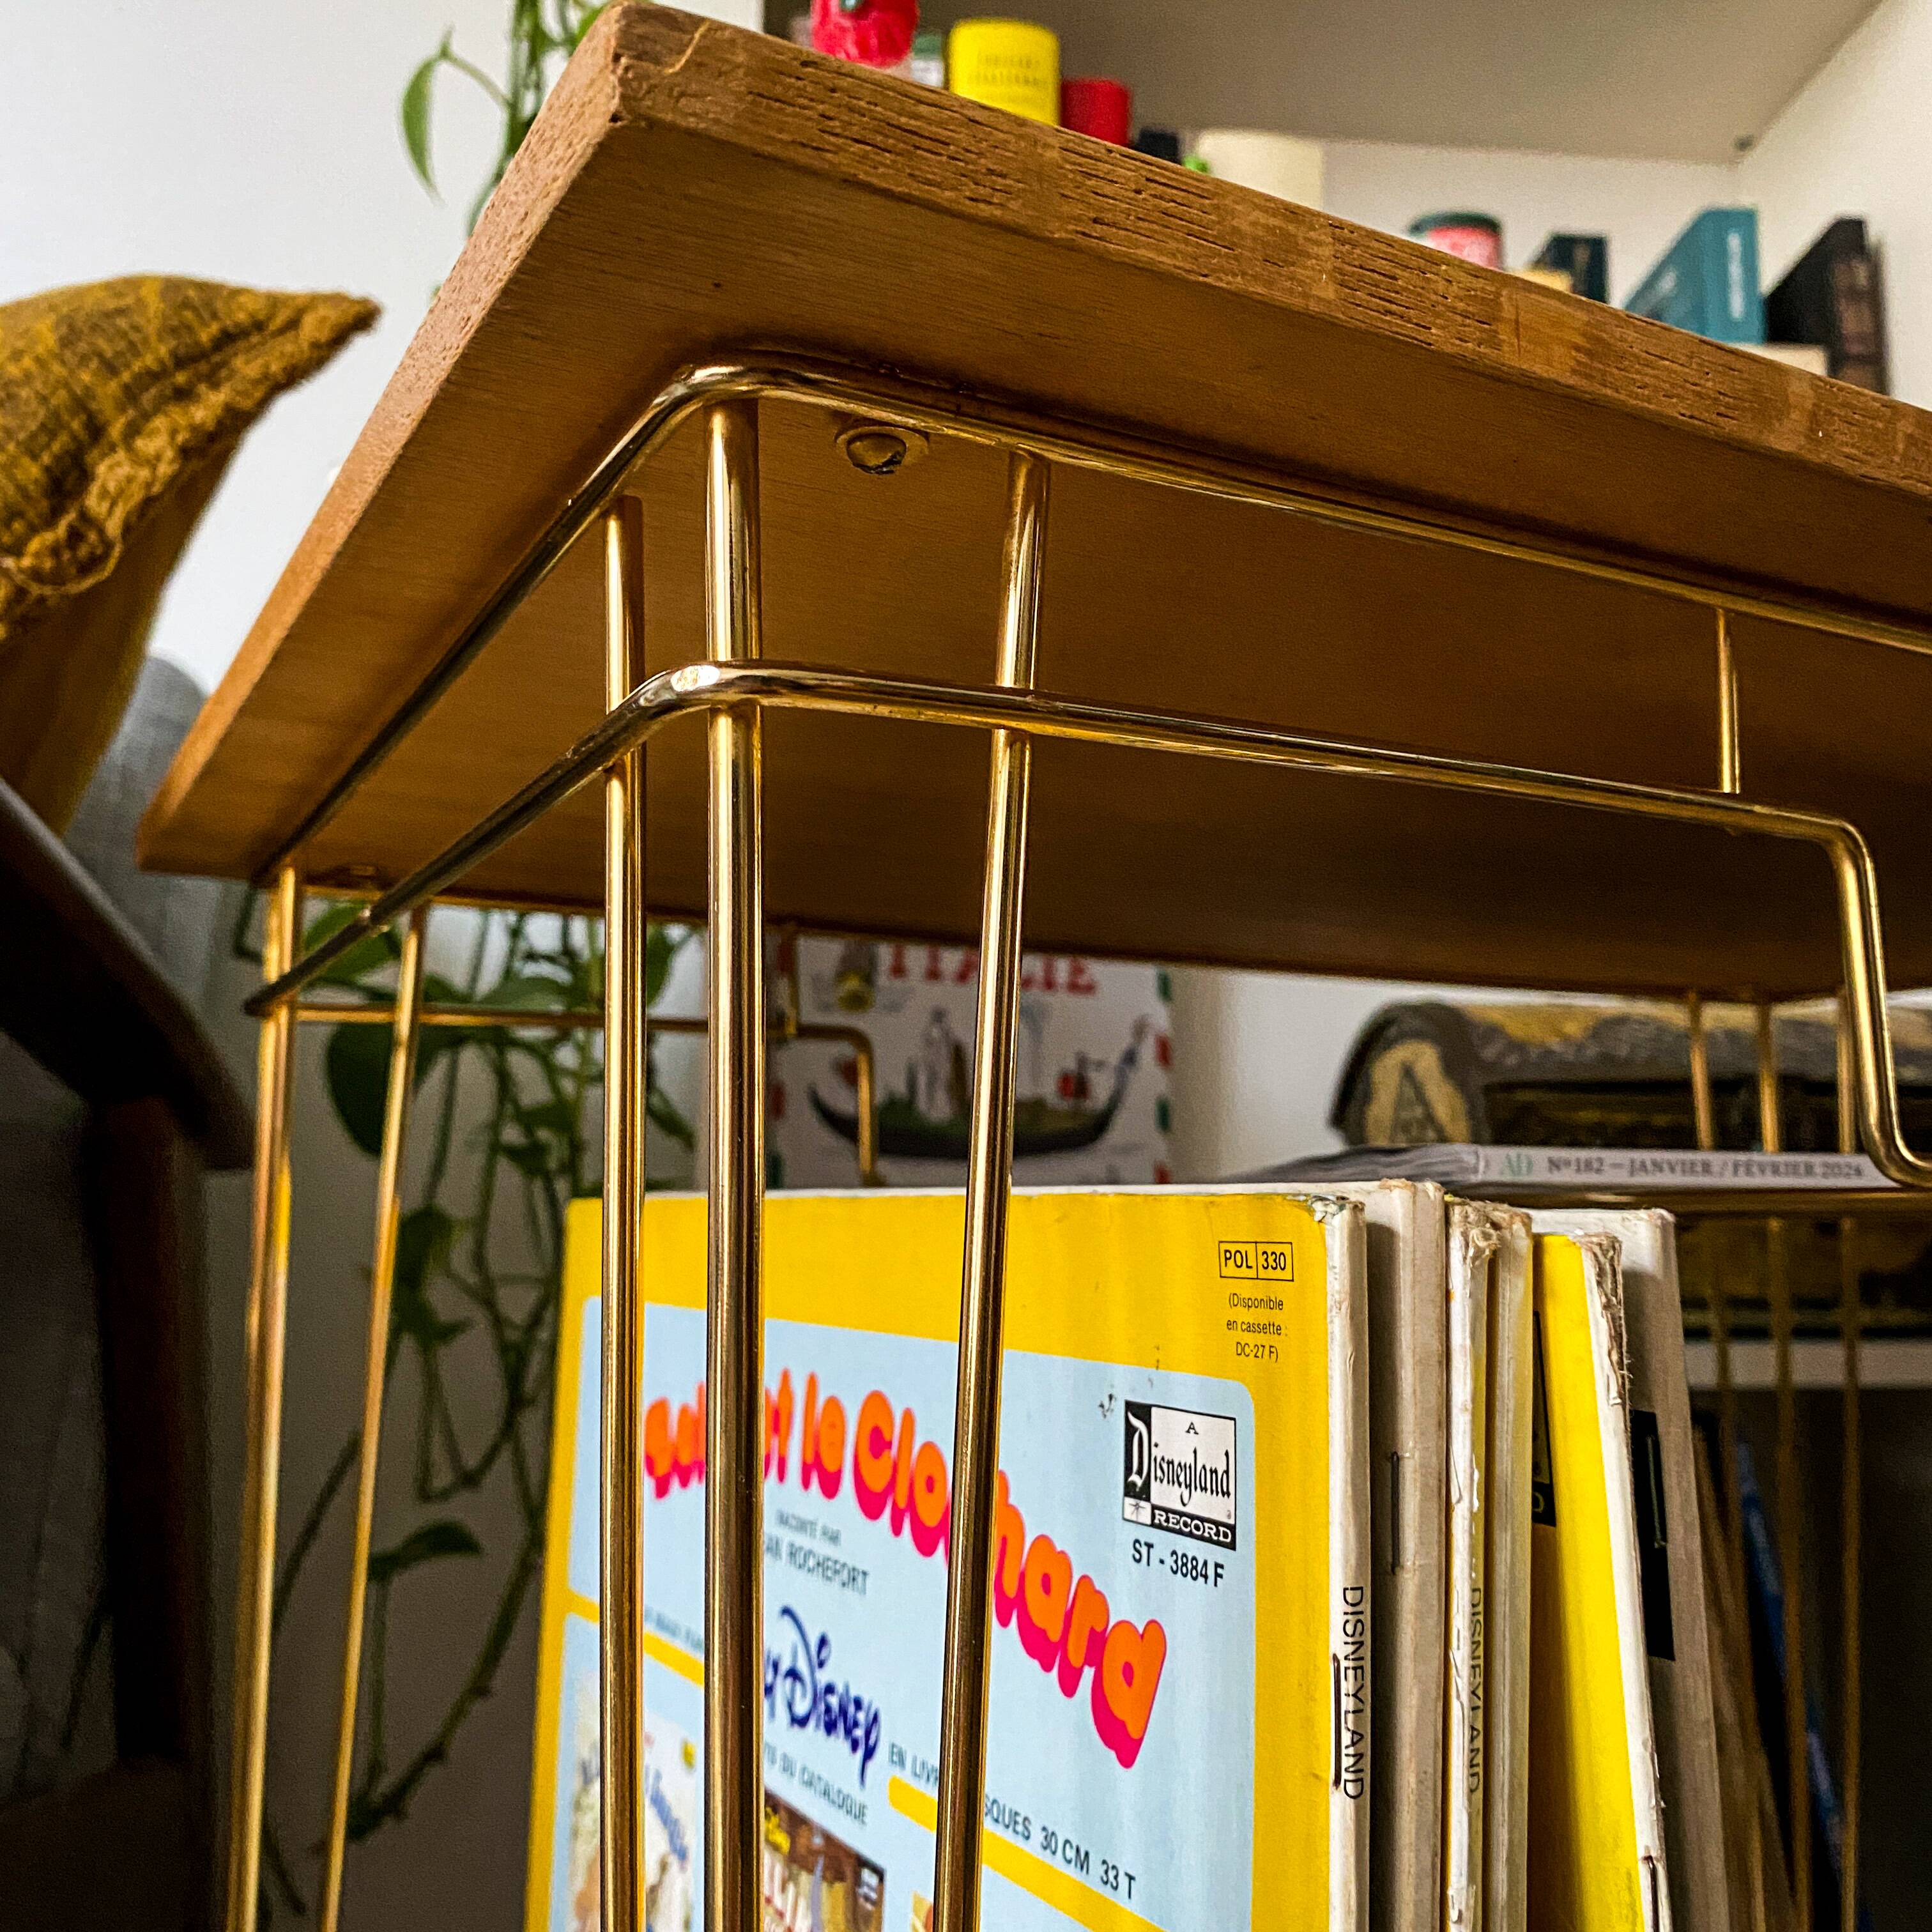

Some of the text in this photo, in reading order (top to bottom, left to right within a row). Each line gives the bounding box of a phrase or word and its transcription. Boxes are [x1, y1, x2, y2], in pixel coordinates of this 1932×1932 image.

[1629, 1158, 1712, 1177] JANVIER
[1223, 1249, 1287, 1271] POL 330
[1228, 1292, 1284, 1312] (Disponible
[1226, 1319, 1238, 1331] en
[1236, 1341, 1279, 1363] DC-27 F)
[1184, 1421, 1199, 1436] A
[1127, 1410, 1231, 1507] Disneyland
[1153, 1508, 1232, 1543] RECORD
[787, 1538, 869, 1595] ROCHEFORT
[1131, 1538, 1154, 1567] ST
[1169, 1549, 1209, 1585] 3884
[1213, 1560, 1225, 1588] F
[1342, 1586, 1365, 1800] DISNEYLAND
[799, 1763, 868, 1827] CATALOGUE
[888, 1741, 907, 1772] EN
[1040, 1825, 1058, 1856] 30
[1062, 1838, 1089, 1875] CM
[1100, 1859, 1119, 1892] 33
[1124, 1871, 1136, 1900] T
